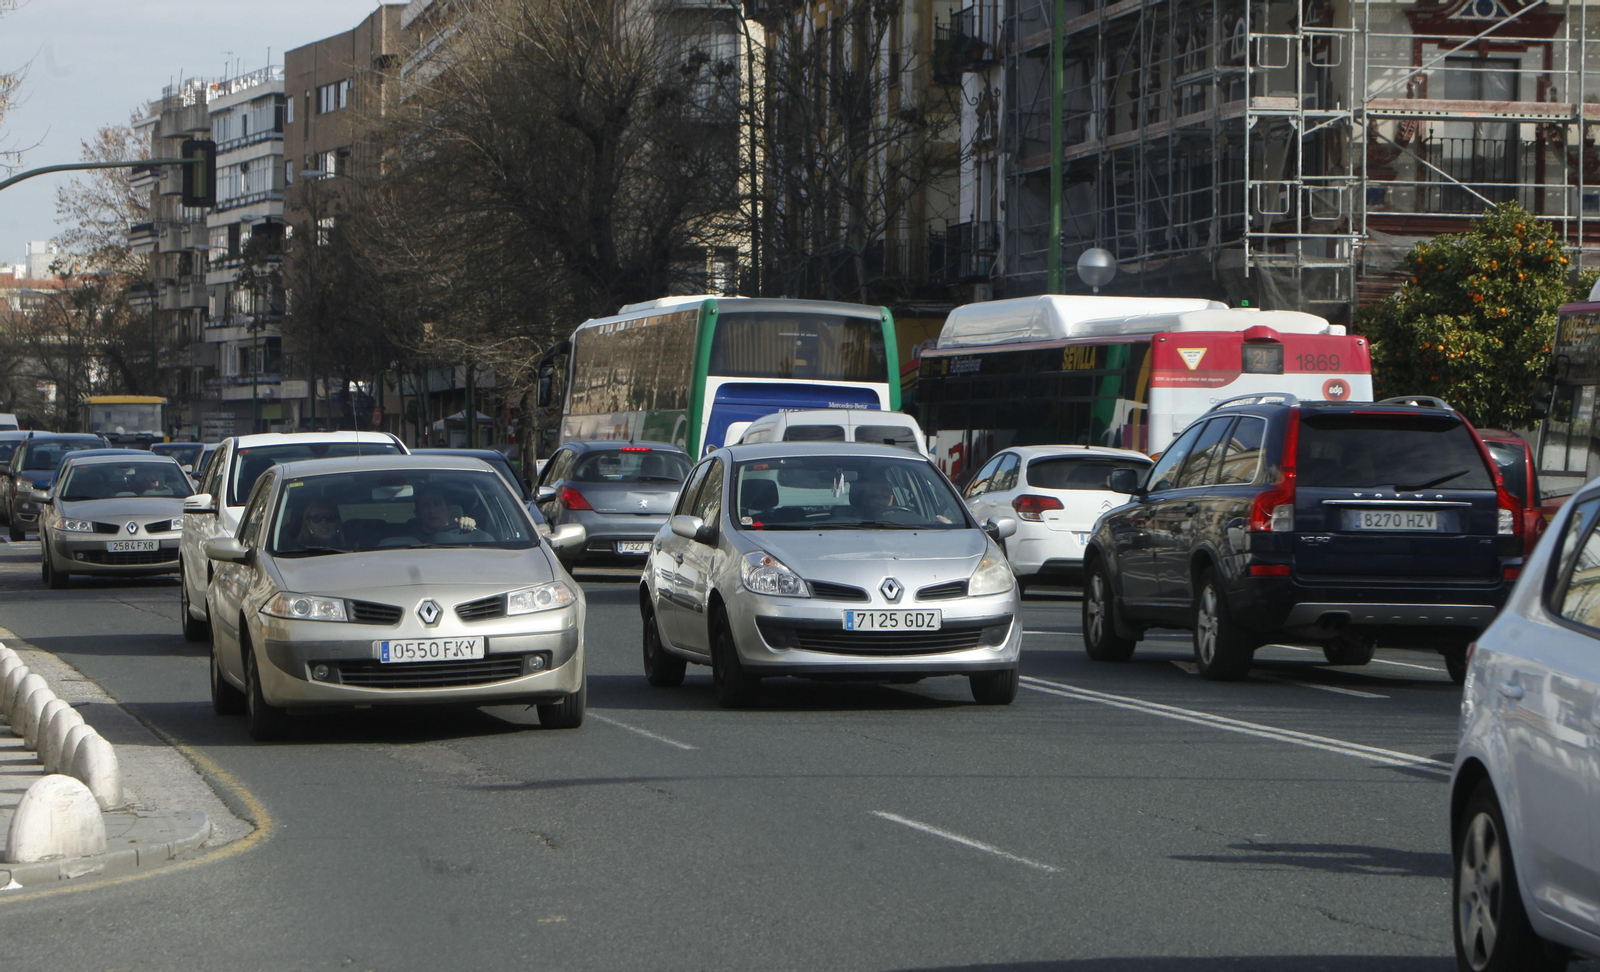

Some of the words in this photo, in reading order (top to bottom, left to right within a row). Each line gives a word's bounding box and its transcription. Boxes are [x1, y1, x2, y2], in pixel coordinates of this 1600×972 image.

[1062, 346, 1096, 371] SEVILLA
[1295, 354, 1340, 372] 1869
[1328, 385, 1343, 396] edp
[828, 401, 868, 409] Mercedes-Benz
[1364, 513, 1402, 527] 8270
[1406, 513, 1434, 528] HZV
[113, 542, 135, 551] 2584
[137, 541, 154, 550] FXR
[624, 541, 645, 551] 7327
[857, 613, 898, 628] 7125
[904, 613, 935, 628] GDZ
[394, 642, 439, 659] 0550
[443, 640, 476, 659] FKY
